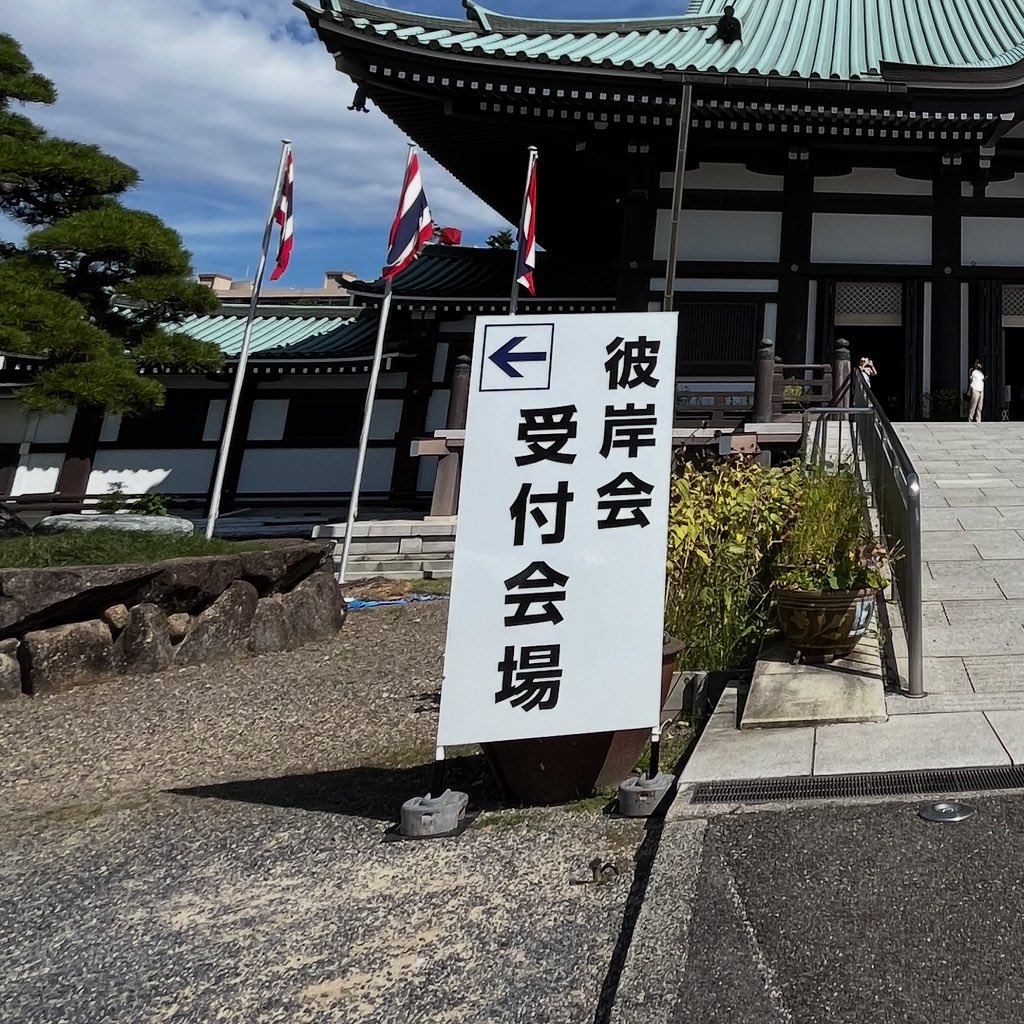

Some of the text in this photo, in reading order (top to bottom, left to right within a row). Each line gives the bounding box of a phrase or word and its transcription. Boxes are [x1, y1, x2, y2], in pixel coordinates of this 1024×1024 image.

[495, 404, 578, 712] 受付会場
[597, 336, 661, 530] 彼岸会
